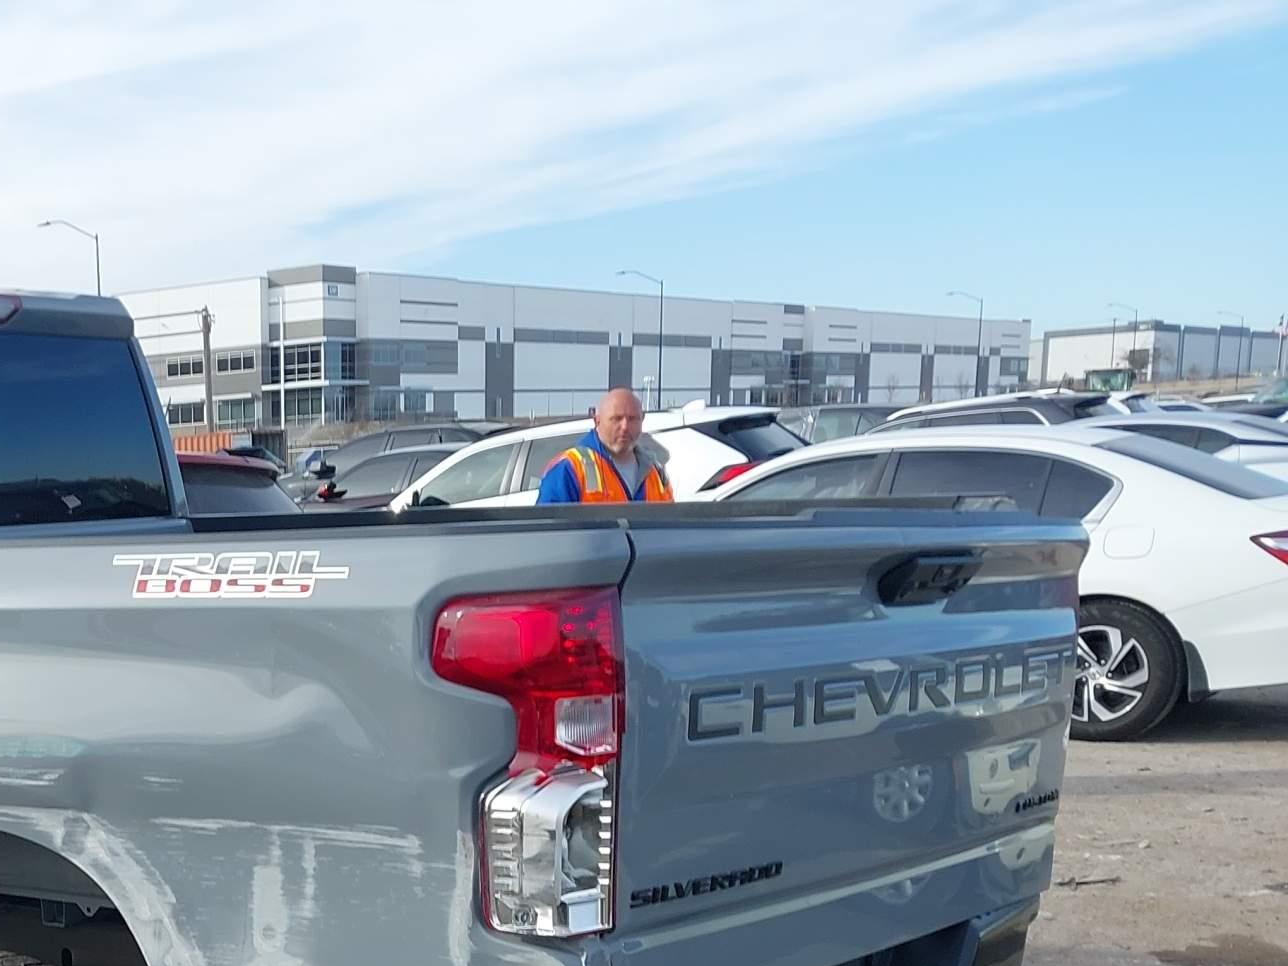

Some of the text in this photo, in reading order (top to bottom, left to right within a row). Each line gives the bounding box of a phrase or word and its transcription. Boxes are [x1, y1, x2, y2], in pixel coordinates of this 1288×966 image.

[113, 550, 350, 577] TRAIL
[132, 575, 316, 599] BOSS
[687, 645, 1074, 742] CHEVROLET
[629, 861, 784, 909] SILVERADO
